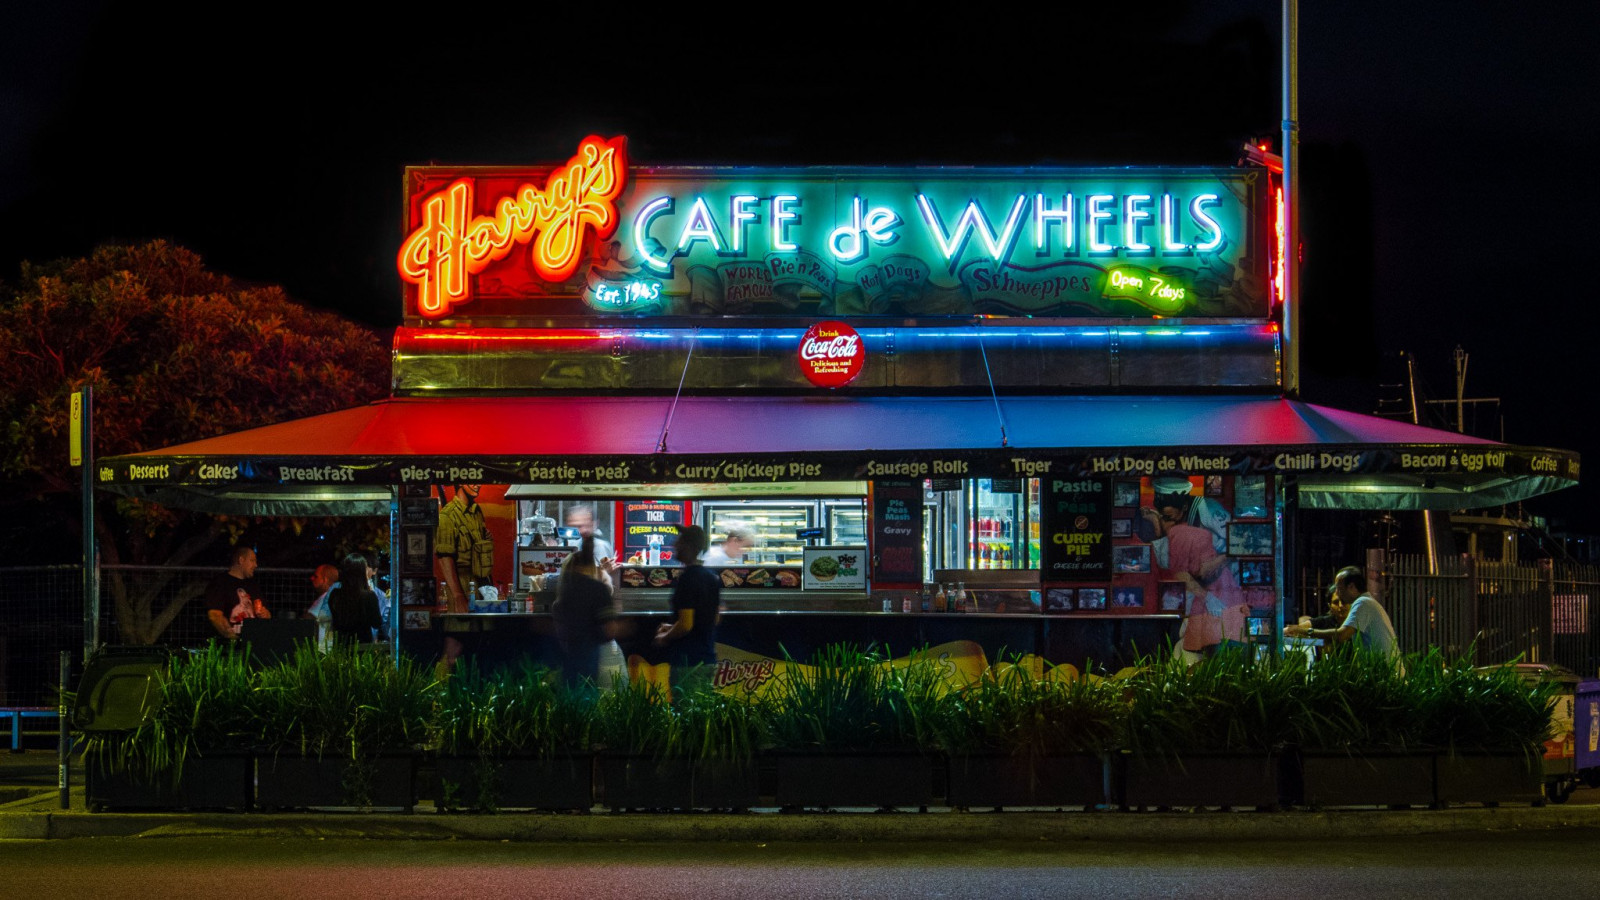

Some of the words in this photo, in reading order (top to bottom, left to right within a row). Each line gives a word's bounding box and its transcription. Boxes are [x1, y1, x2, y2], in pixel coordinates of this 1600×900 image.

[399, 139, 623, 315] Harry's
[634, 195, 803, 277] CAFE
[829, 194, 901, 264] de
[911, 191, 1224, 264] WHEELS
[725, 266, 771, 282] WORLD
[860, 272, 880, 288] Hot
[883, 263, 920, 281] Dogs
[971, 266, 1092, 300] Schweppes
[1111, 269, 1144, 291] Open
[621, 282, 661, 306] 1945
[727, 284, 773, 301] FAMOUS
[801, 335, 859, 360] Coca-Cola
[675, 462, 720, 480] Curry
[722, 461, 785, 479] Chicken
[789, 461, 822, 477] Pies
[867, 460, 928, 478] Sausage
[933, 459, 968, 476] Rolls
[1011, 457, 1052, 477] Tiger
[1093, 456, 1121, 472] Hot
[1123, 456, 1155, 474] Dog
[1157, 455, 1177, 470] de
[1179, 454, 1231, 471] Wheels
[1274, 453, 1316, 470] Chilli
[1319, 453, 1360, 471] Dogs
[1401, 453, 1446, 469] Bacon
[1449, 455, 1459, 466] &
[1460, 453, 1484, 471] egg
[1486, 452, 1506, 468] roll
[1530, 455, 1558, 472] Coffee
[130, 464, 169, 481] Desserts
[198, 464, 238, 480] Cakes
[279, 465, 355, 481] Breakfast
[1051, 479, 1104, 493] Pastie
[886, 506, 909, 514] Peas
[888, 499, 904, 507] Pie
[884, 513, 911, 521] Mash
[883, 526, 912, 536] Gravy
[1052, 532, 1104, 545] CURRY
[1066, 544, 1091, 556] PIE
[713, 658, 775, 694] Harry's
